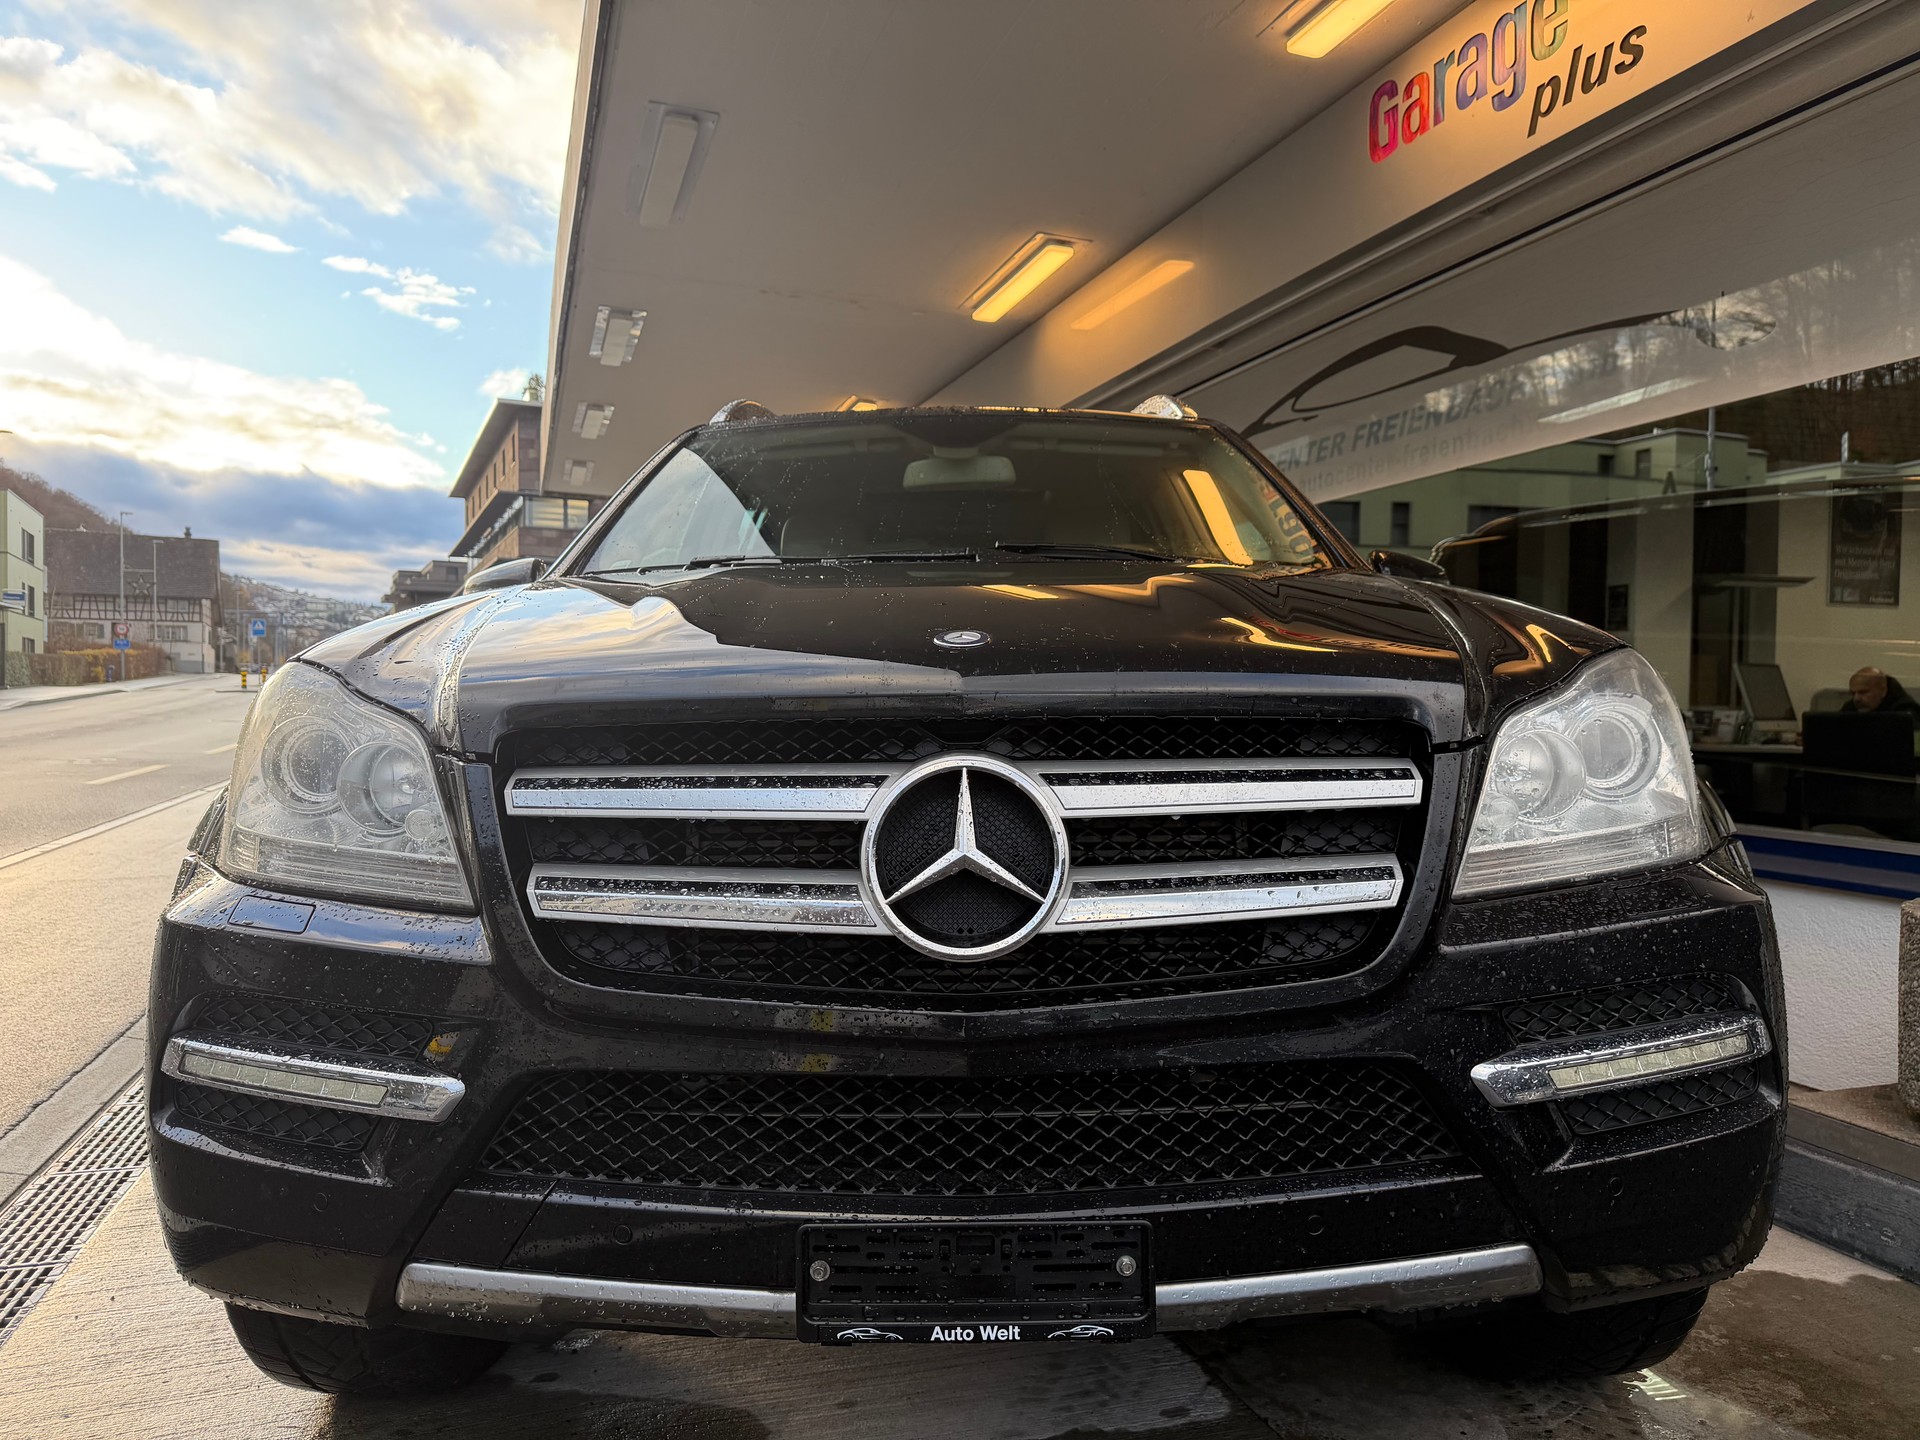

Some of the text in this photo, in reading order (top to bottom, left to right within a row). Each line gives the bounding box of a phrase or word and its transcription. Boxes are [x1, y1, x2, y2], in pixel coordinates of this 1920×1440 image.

[1368, 0, 1569, 163] Garage
[1527, 25, 1647, 138] plus
[930, 1324, 1021, 1341] Auto Welt
